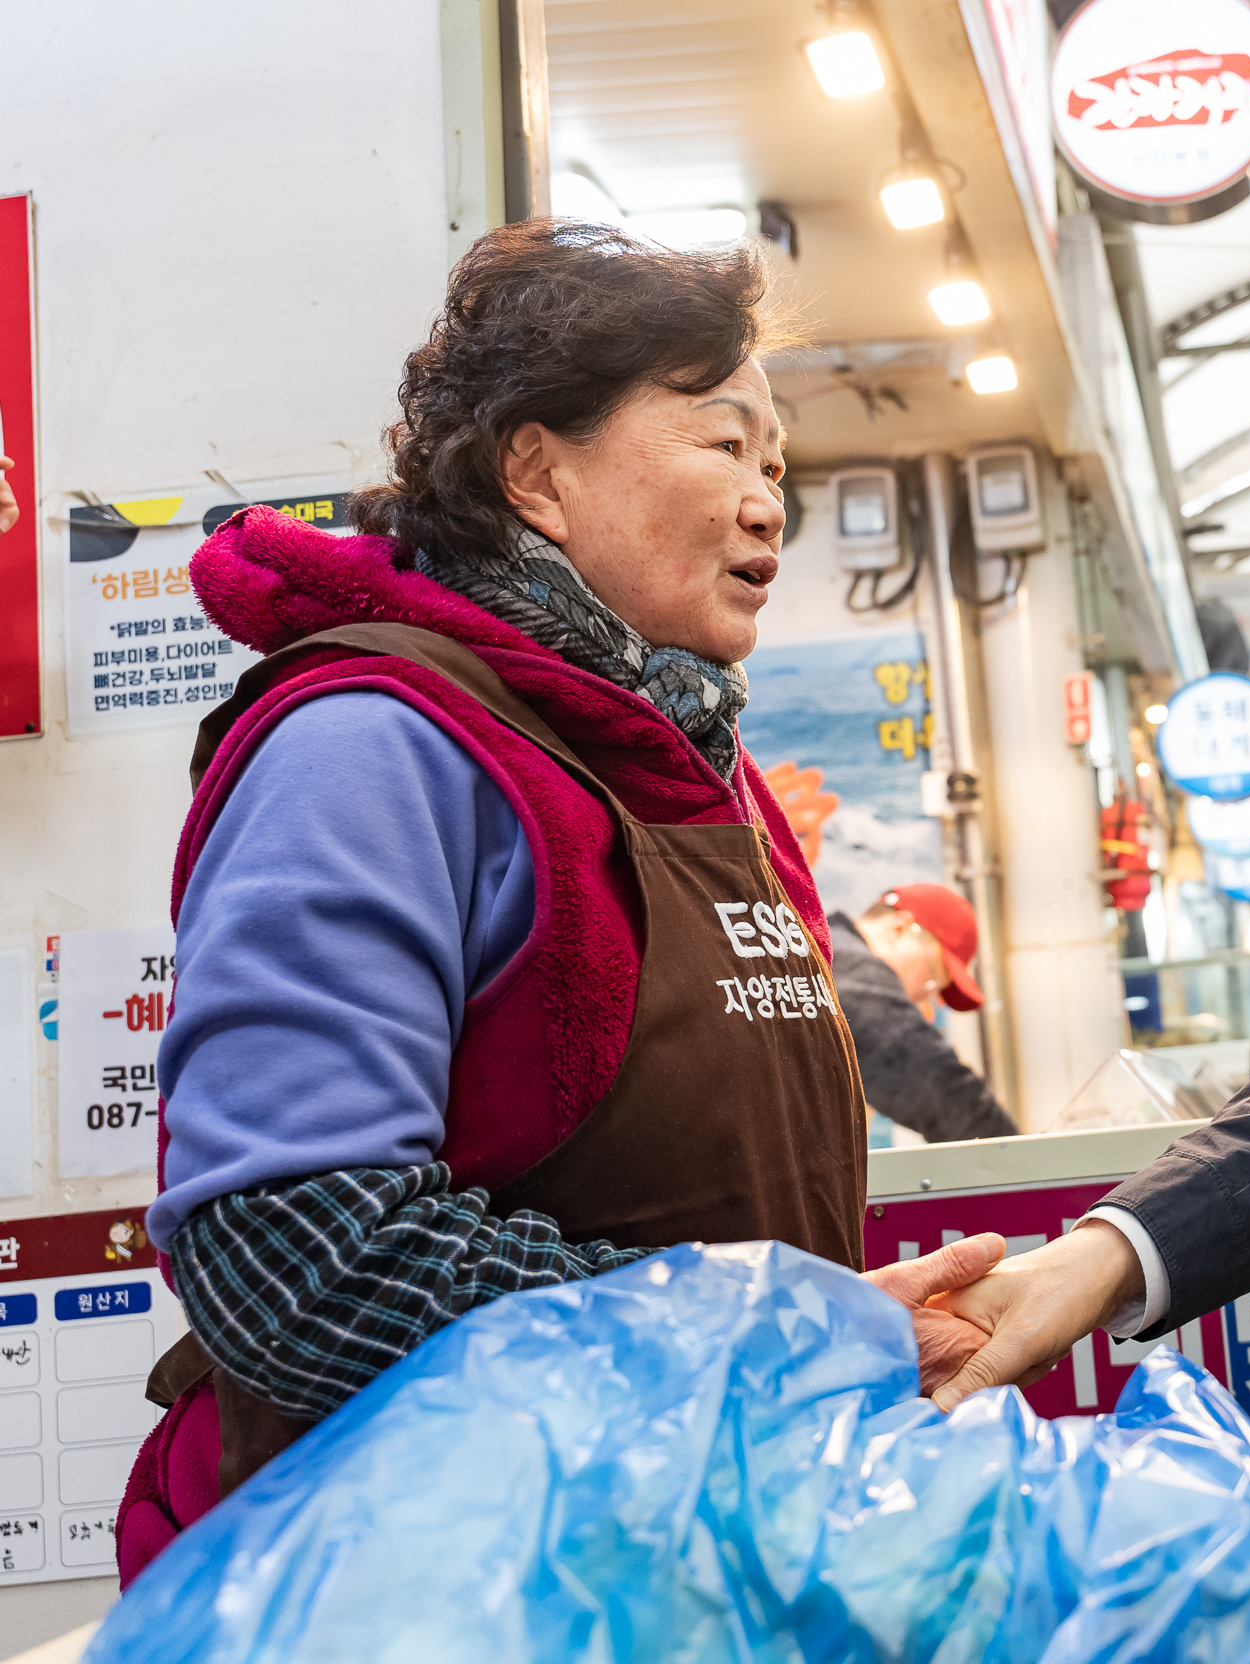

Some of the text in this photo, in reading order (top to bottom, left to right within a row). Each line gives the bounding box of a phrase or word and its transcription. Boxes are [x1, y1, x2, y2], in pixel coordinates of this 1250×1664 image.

[713, 900, 810, 958] ESG
[102, 1063, 156, 1093] 국민
[77, 1288, 130, 1314] 원산지
